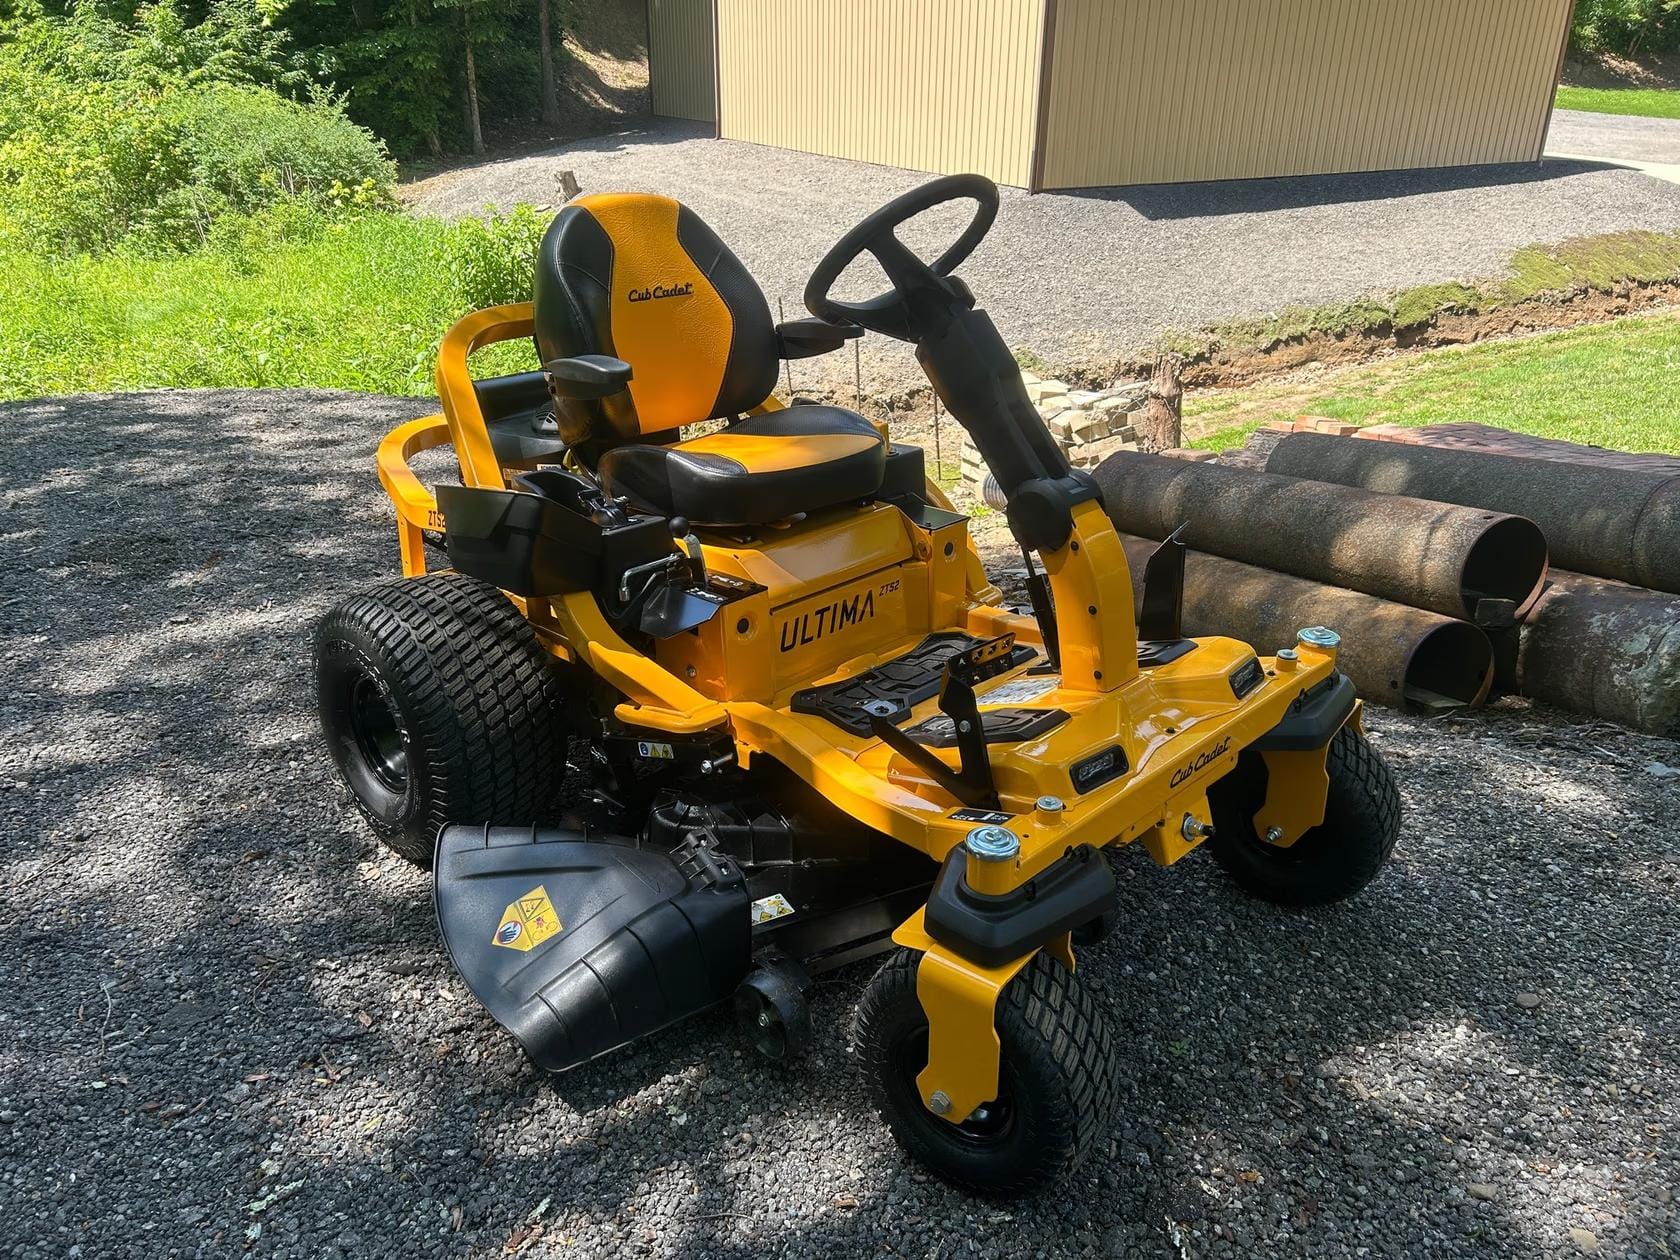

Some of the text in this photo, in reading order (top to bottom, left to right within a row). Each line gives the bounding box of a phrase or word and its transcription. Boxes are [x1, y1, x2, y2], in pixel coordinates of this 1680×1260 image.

[628, 282, 693, 302] Cub Cadet
[780, 589, 874, 653] ULTIMA
[1170, 735, 1231, 788] Cub Cadet
